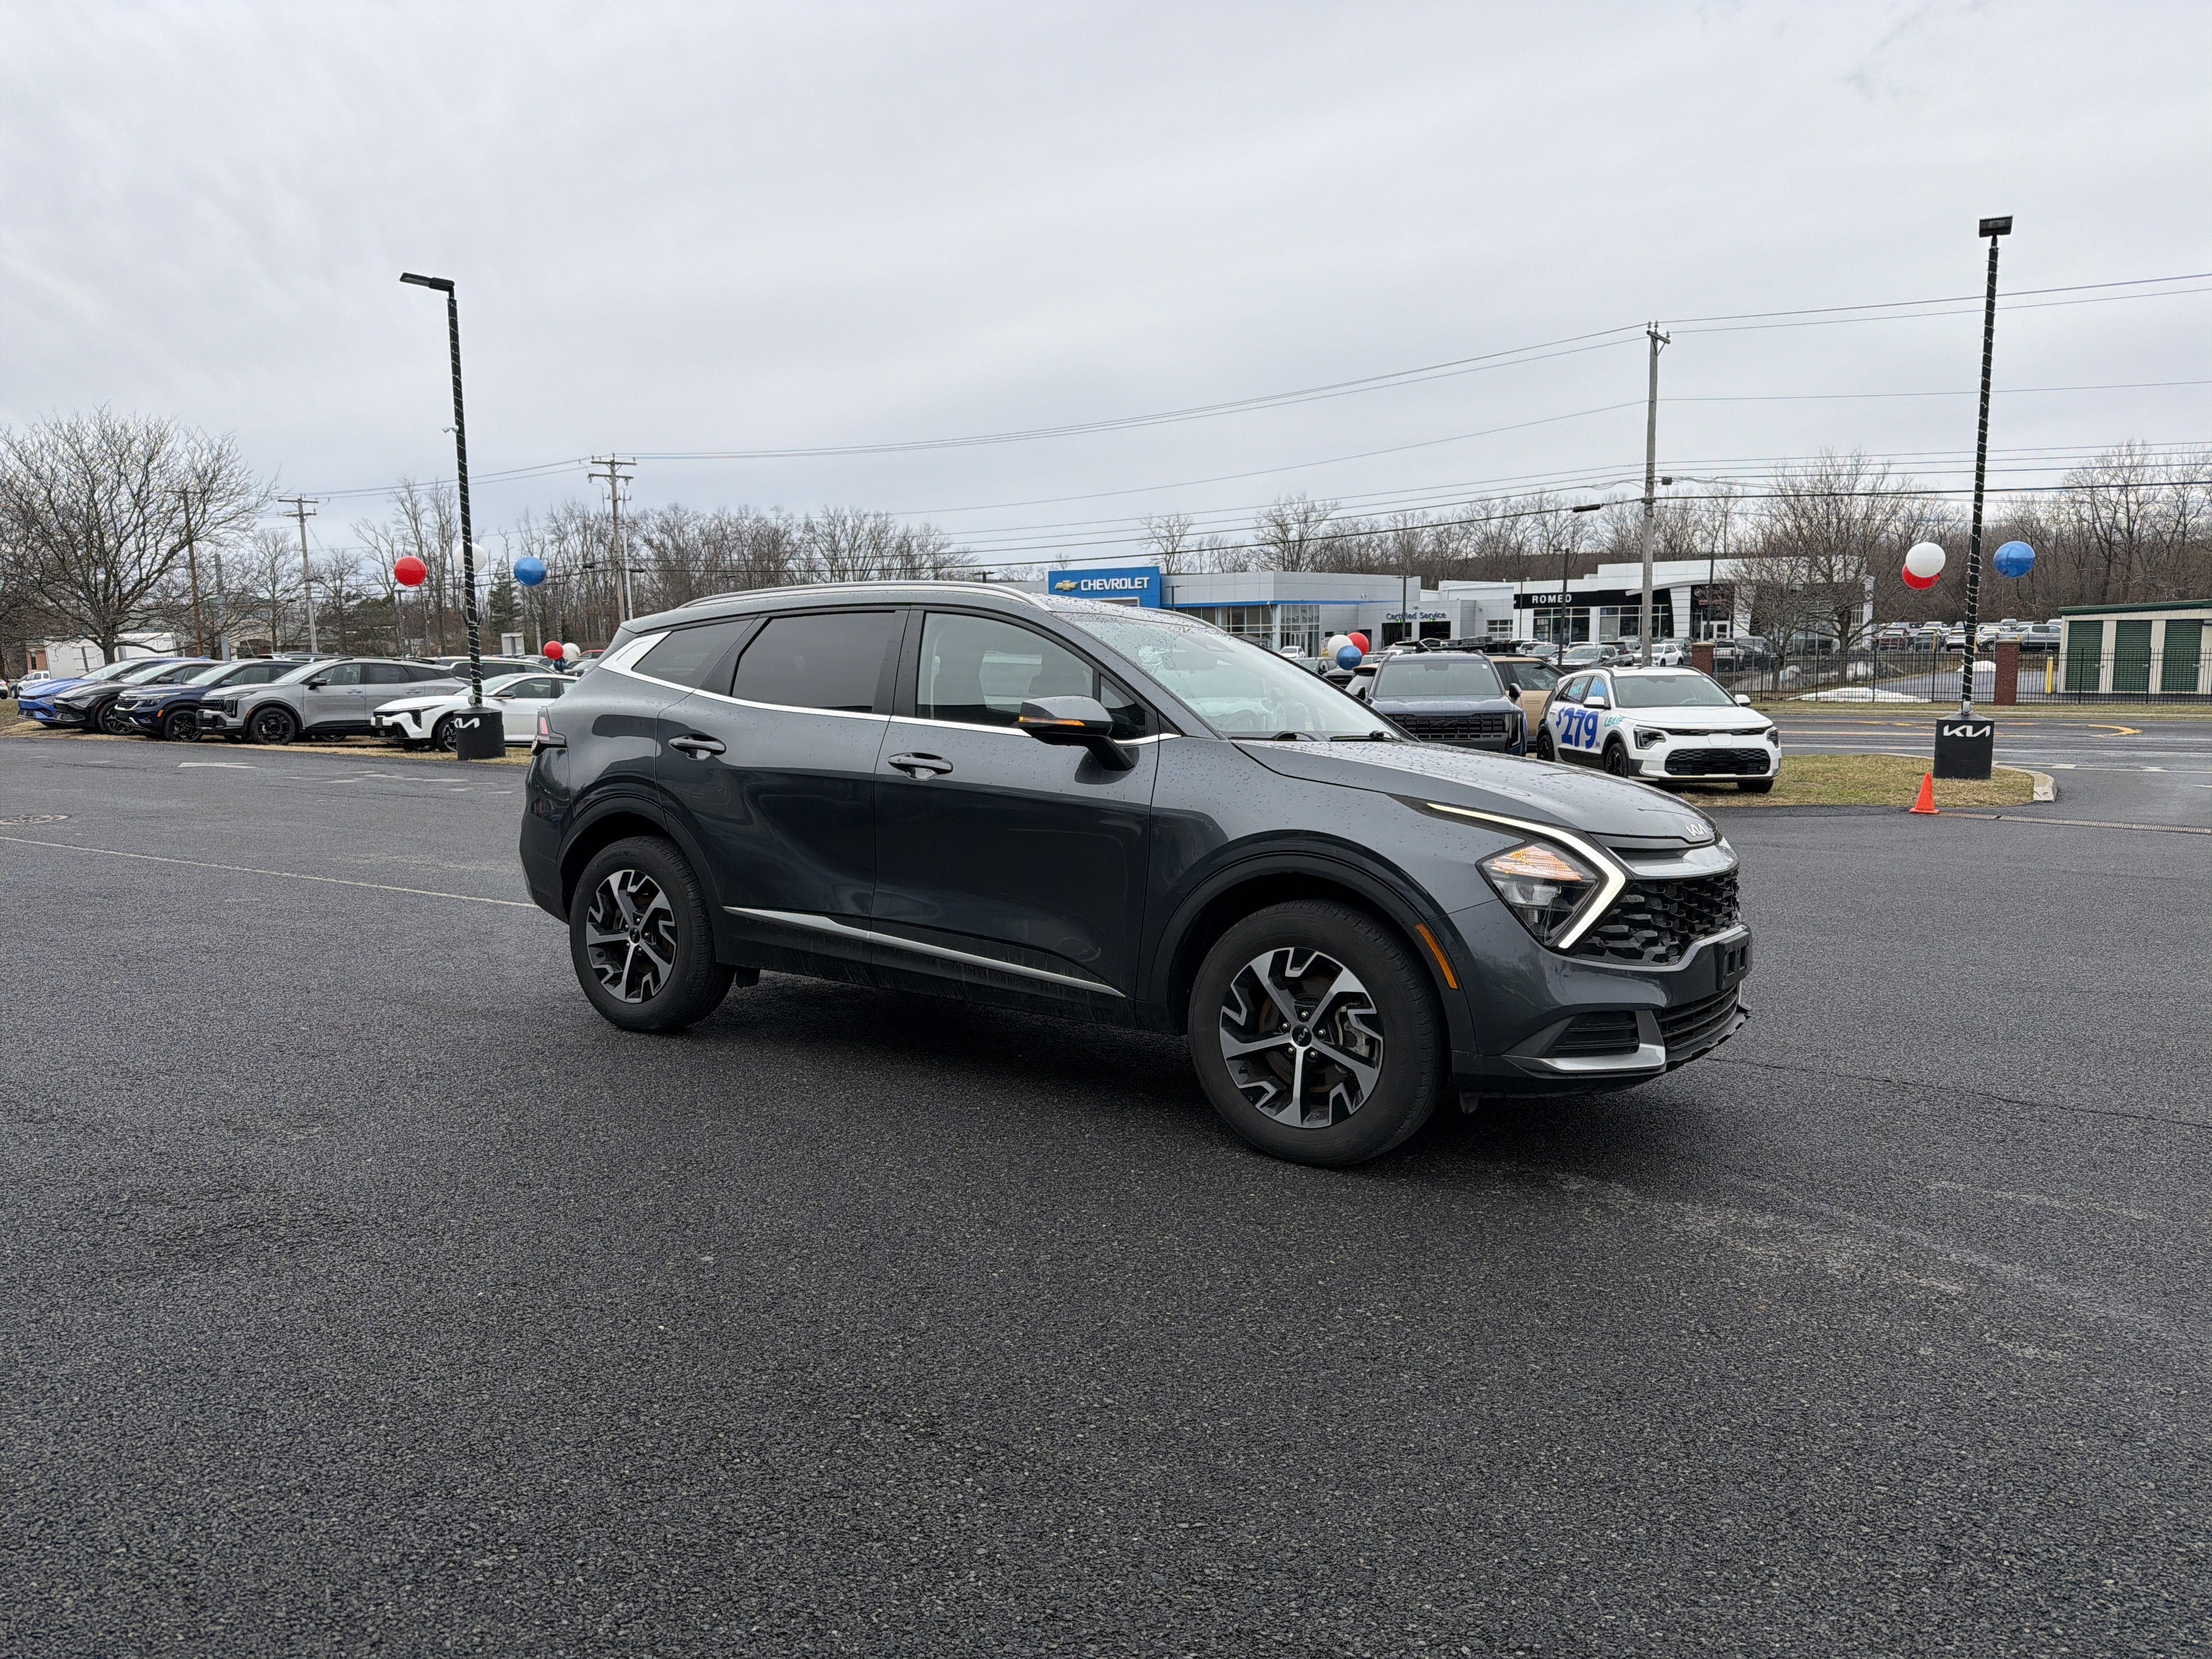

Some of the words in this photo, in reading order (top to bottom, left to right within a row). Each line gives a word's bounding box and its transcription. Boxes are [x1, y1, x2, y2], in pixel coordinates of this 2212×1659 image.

[1081, 577, 1150, 591] CHEVROLET
[1532, 594, 1572, 604] ROMEO
[1604, 716, 1624, 727] LEASE
[1943, 724, 1991, 737] KIA
[1685, 823, 1708, 837] KIA
